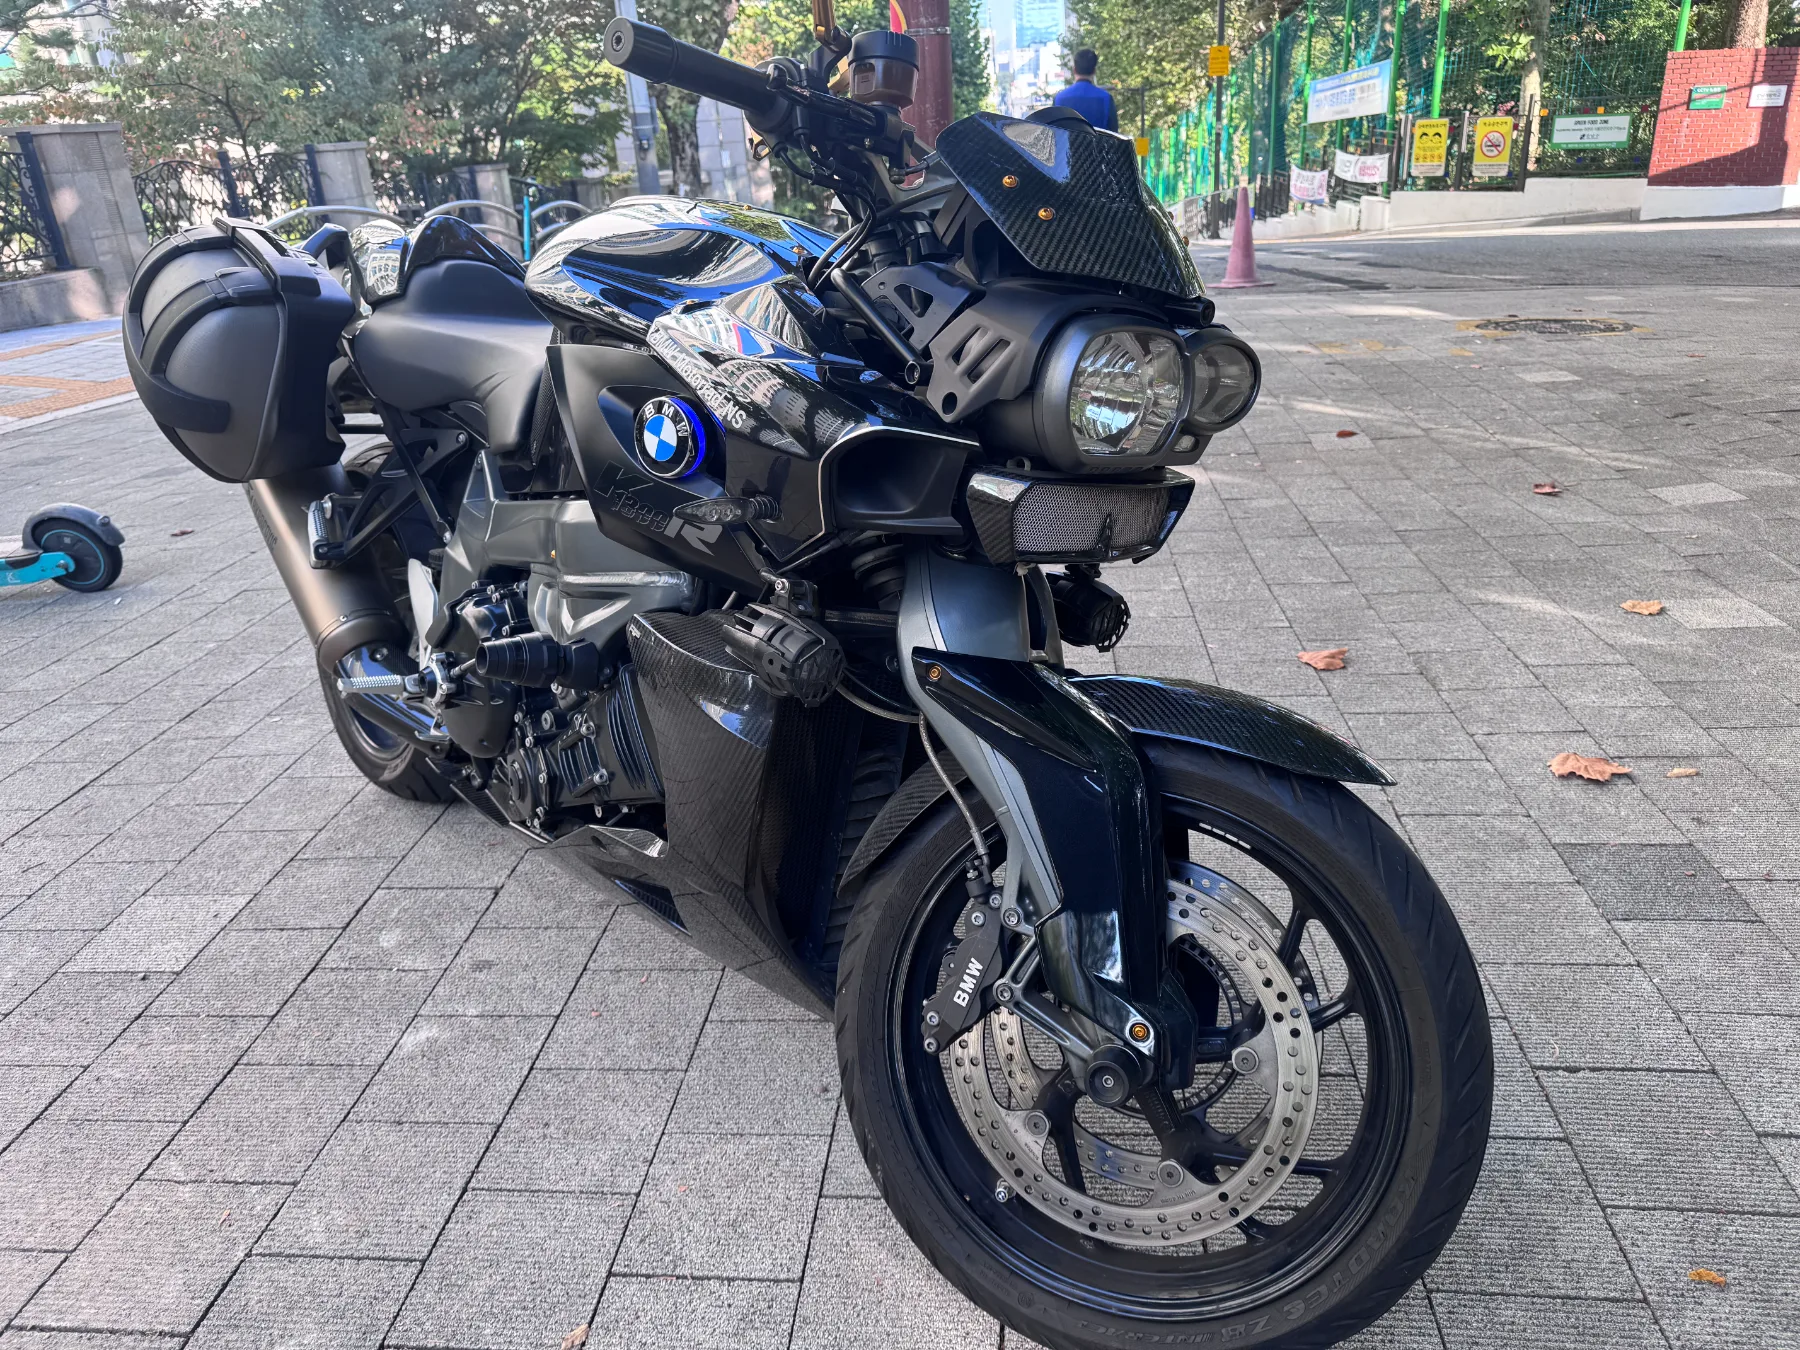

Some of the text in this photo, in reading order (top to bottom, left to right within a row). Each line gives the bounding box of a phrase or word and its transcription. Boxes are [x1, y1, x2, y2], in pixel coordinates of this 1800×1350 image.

[650, 331, 747, 429] BMW Motorrad NS
[644, 402, 689, 437] BMW
[953, 957, 983, 1007] BMW
